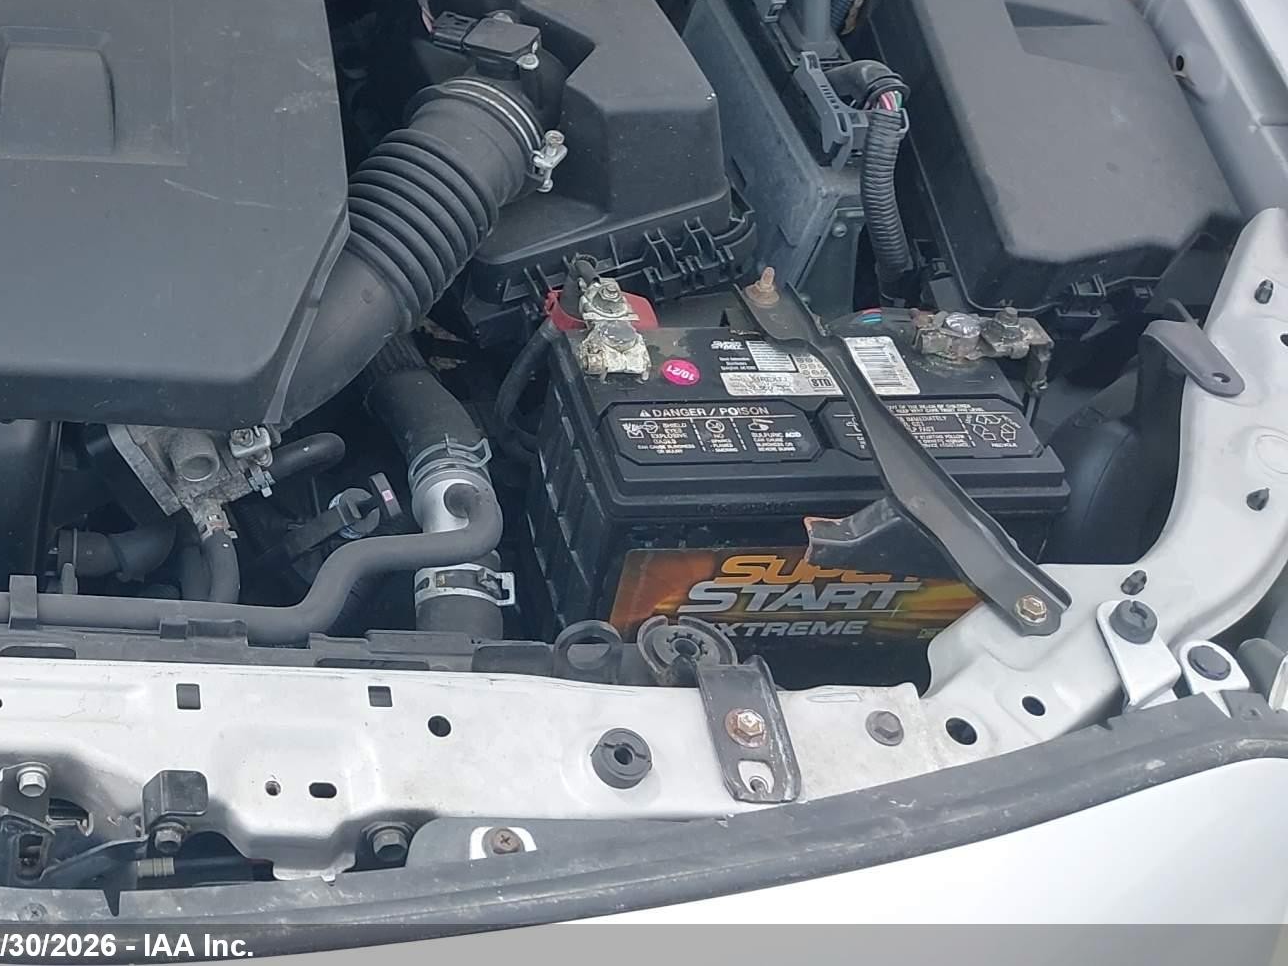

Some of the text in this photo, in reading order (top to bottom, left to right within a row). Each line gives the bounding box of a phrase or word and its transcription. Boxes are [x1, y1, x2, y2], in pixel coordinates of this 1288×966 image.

[666, 365, 696, 382] 10/21
[811, 378, 832, 388] STD
[652, 408, 707, 417] DANGER
[719, 406, 770, 416] POISON
[678, 581, 922, 612] START
